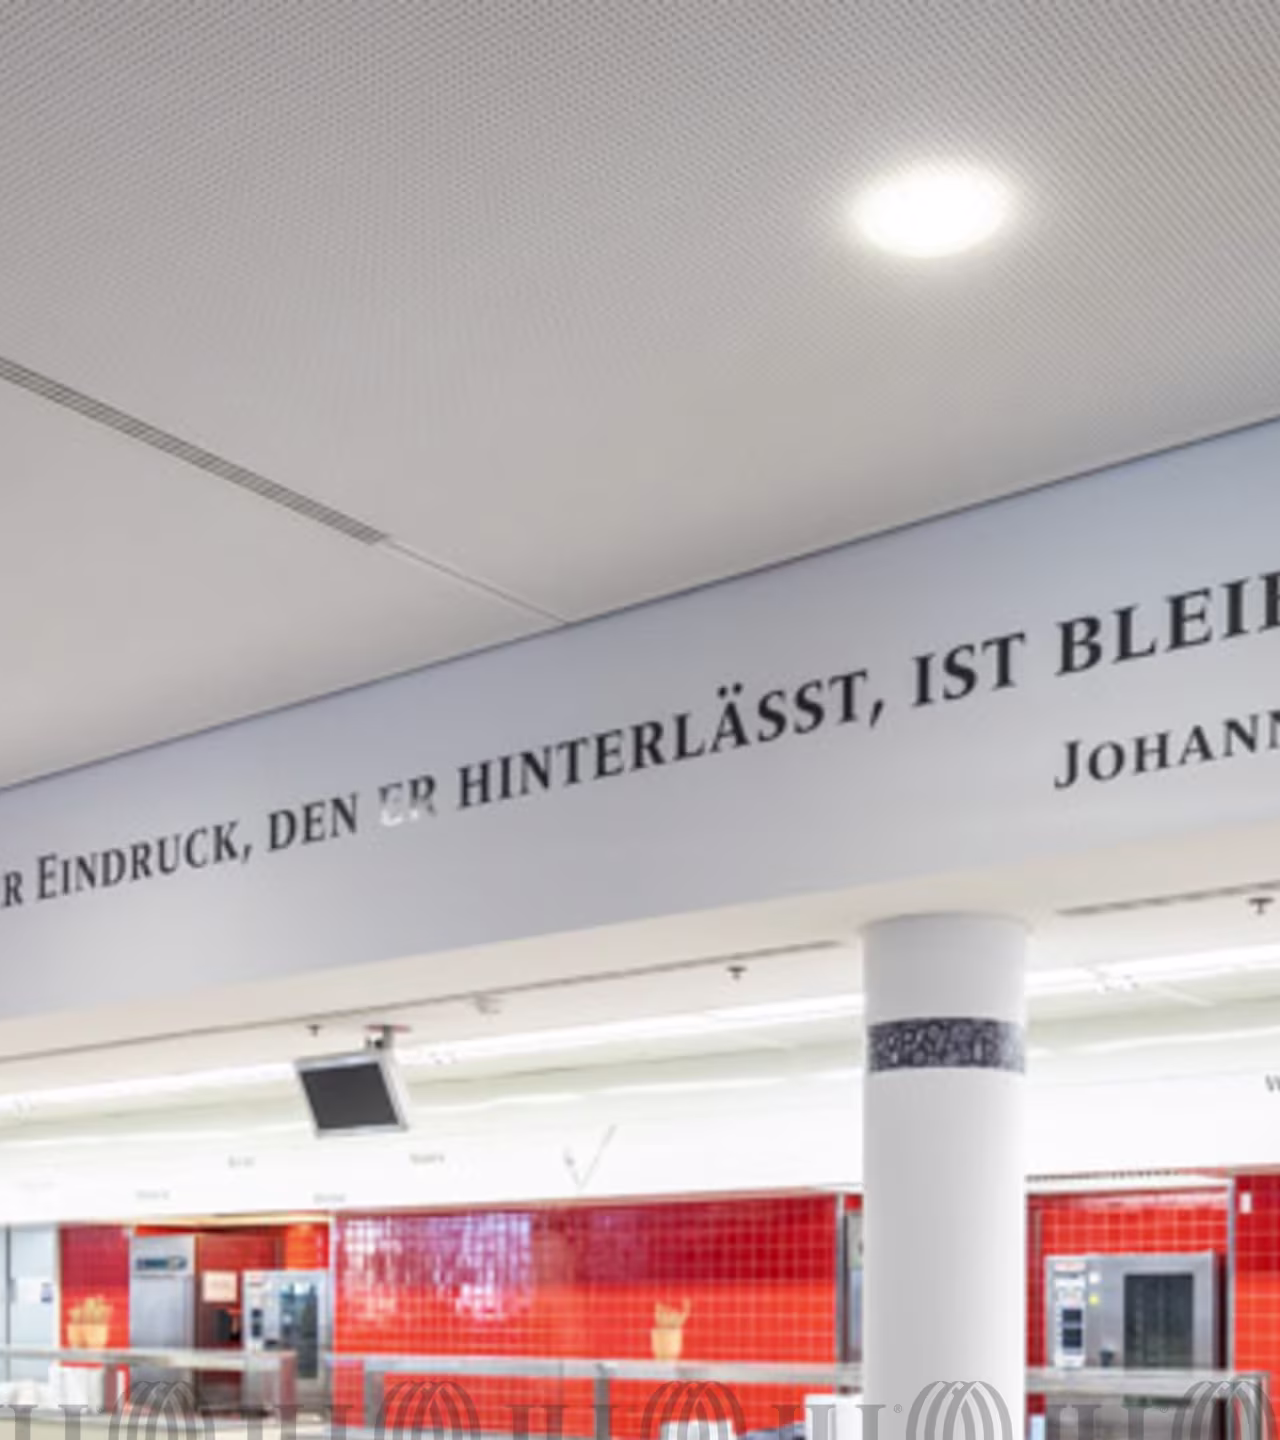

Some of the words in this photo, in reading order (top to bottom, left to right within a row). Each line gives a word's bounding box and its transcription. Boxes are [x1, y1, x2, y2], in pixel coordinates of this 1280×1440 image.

[37, 820, 253, 902] EINDRUCK,
[267, 792, 360, 853] DEN
[378, 775, 438, 826] ER
[456, 668, 886, 811] HINTERLÄSST,
[911, 631, 1026, 710] IST
